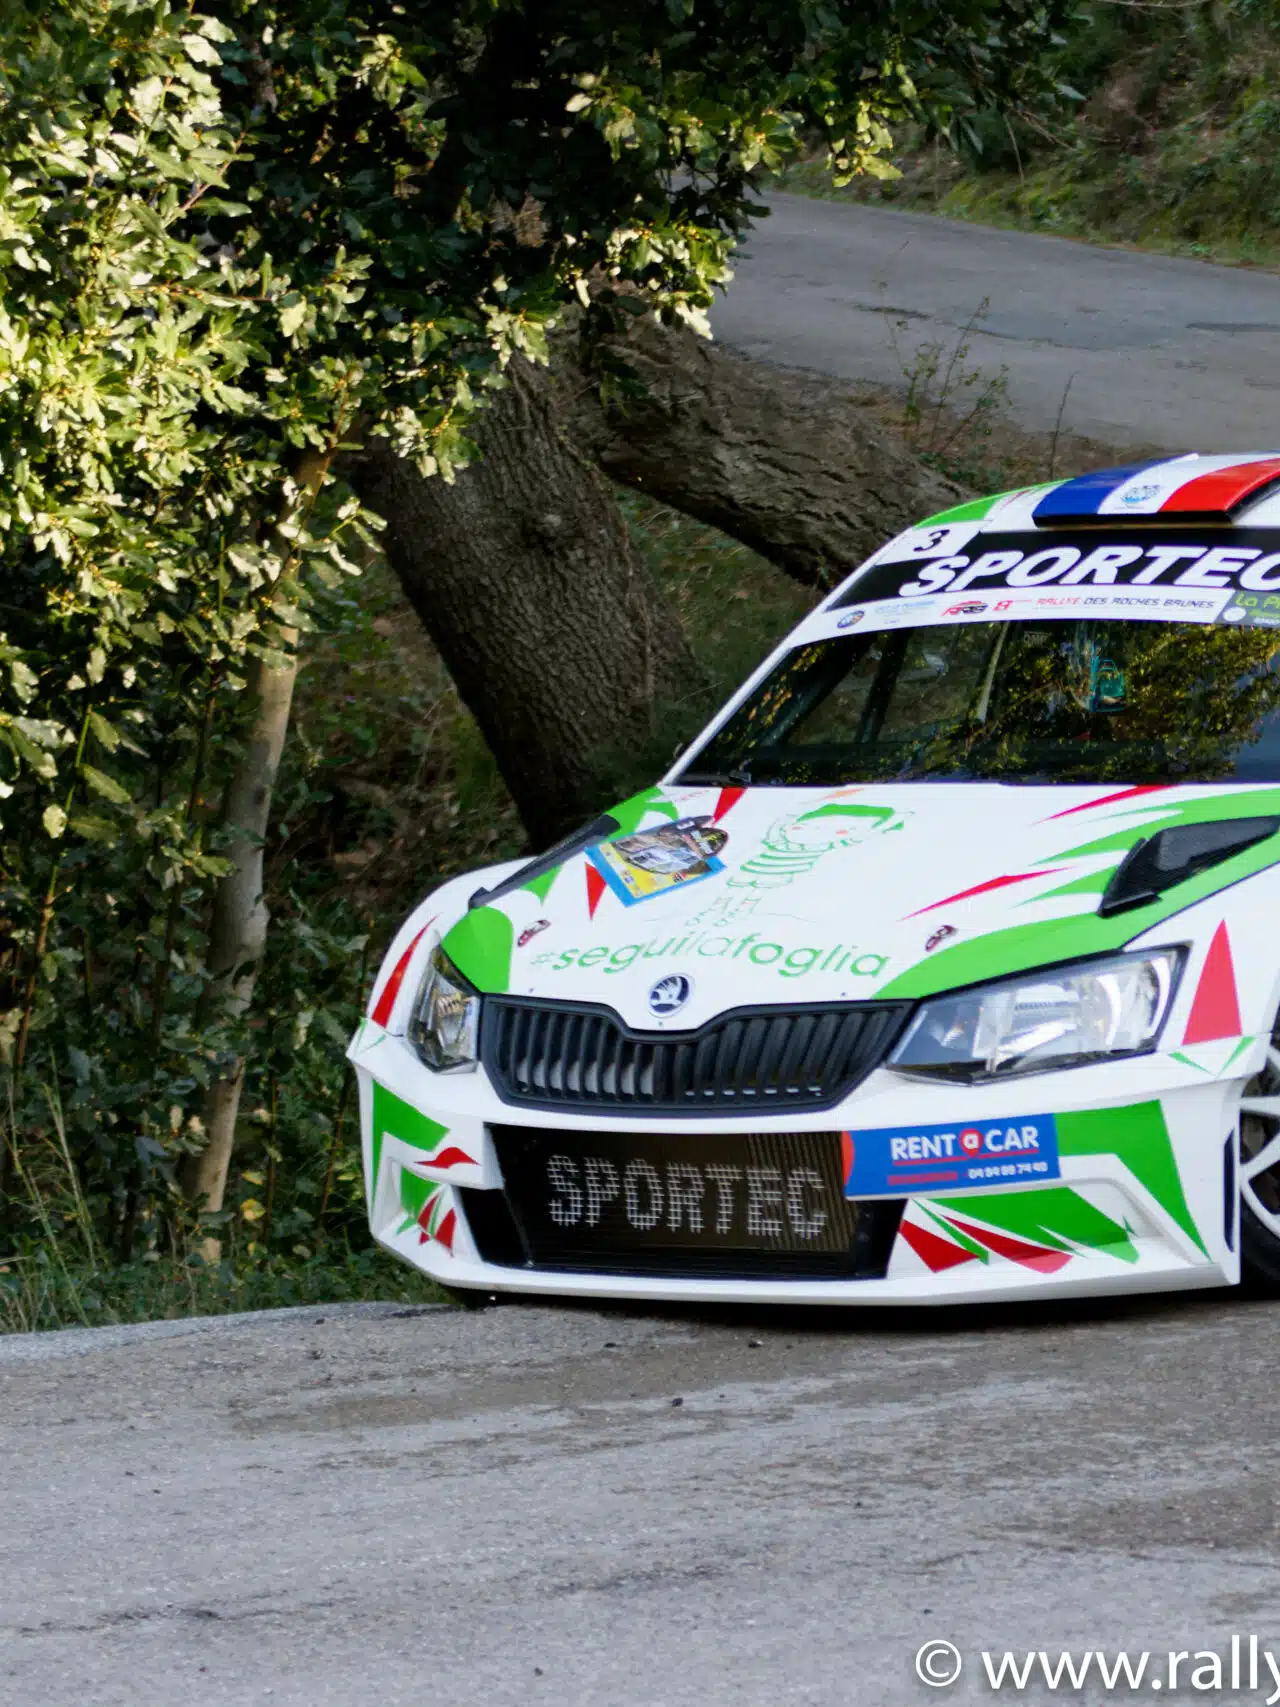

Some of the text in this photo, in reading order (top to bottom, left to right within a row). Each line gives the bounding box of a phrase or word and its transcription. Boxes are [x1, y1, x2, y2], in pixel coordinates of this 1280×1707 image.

[912, 528, 951, 552] 3
[1035, 597, 1216, 609] RALLYE DES ROCHES BRUNES
[1235, 592, 1258, 607] La
[530, 931, 892, 978] #seguilafoglia
[890, 1133, 957, 1161] RENT
[984, 1125, 1040, 1152] CAR
[546, 1154, 829, 1241] SPORTEC
